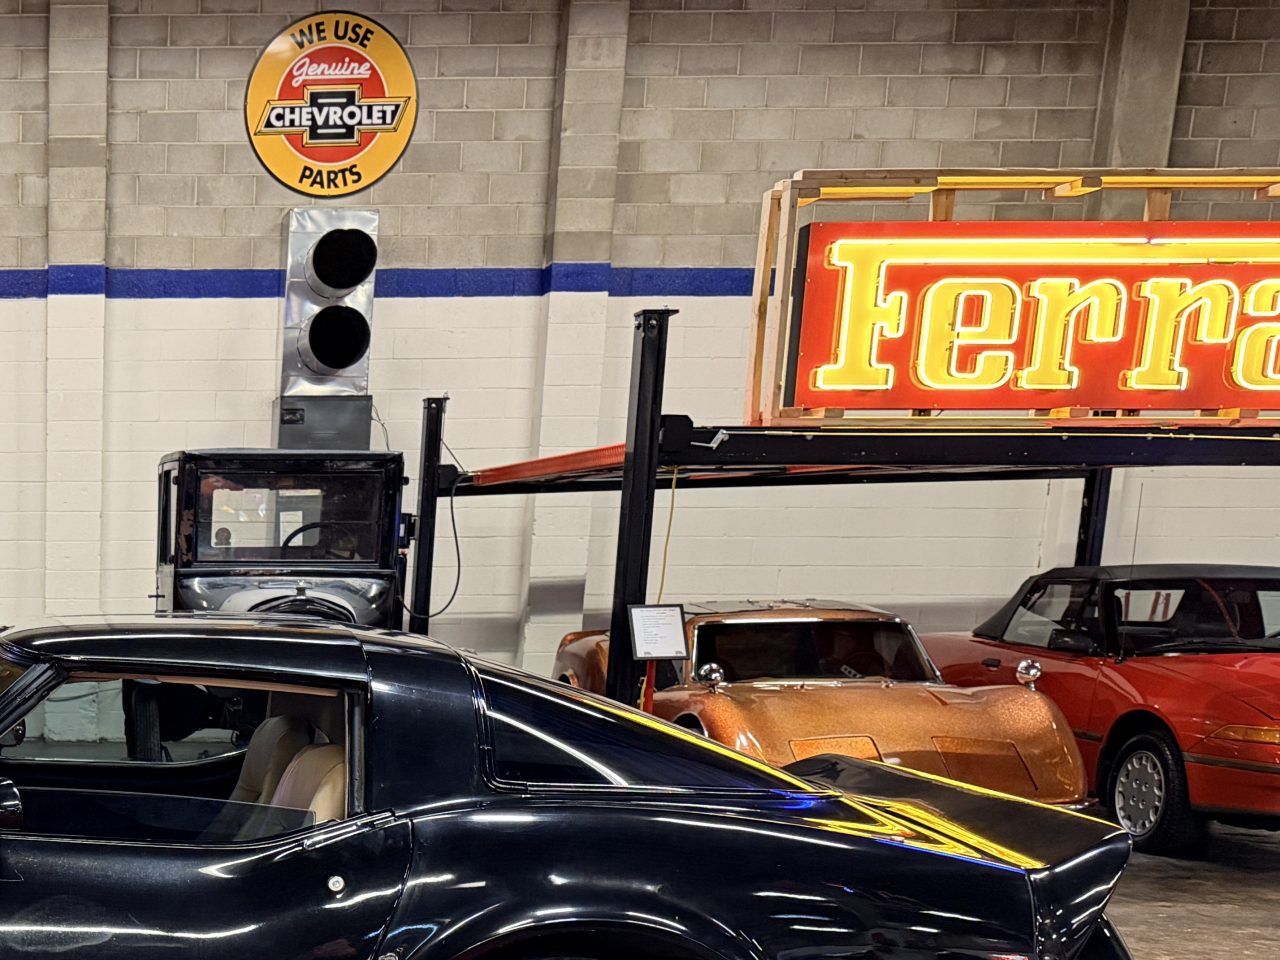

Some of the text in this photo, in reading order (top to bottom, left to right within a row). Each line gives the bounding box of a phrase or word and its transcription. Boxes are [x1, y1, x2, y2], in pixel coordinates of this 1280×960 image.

[290, 20, 374, 50] WE USE
[292, 57, 371, 87] Genuine
[270, 105, 396, 127] CHEVROLET
[298, 164, 362, 189] PARTS
